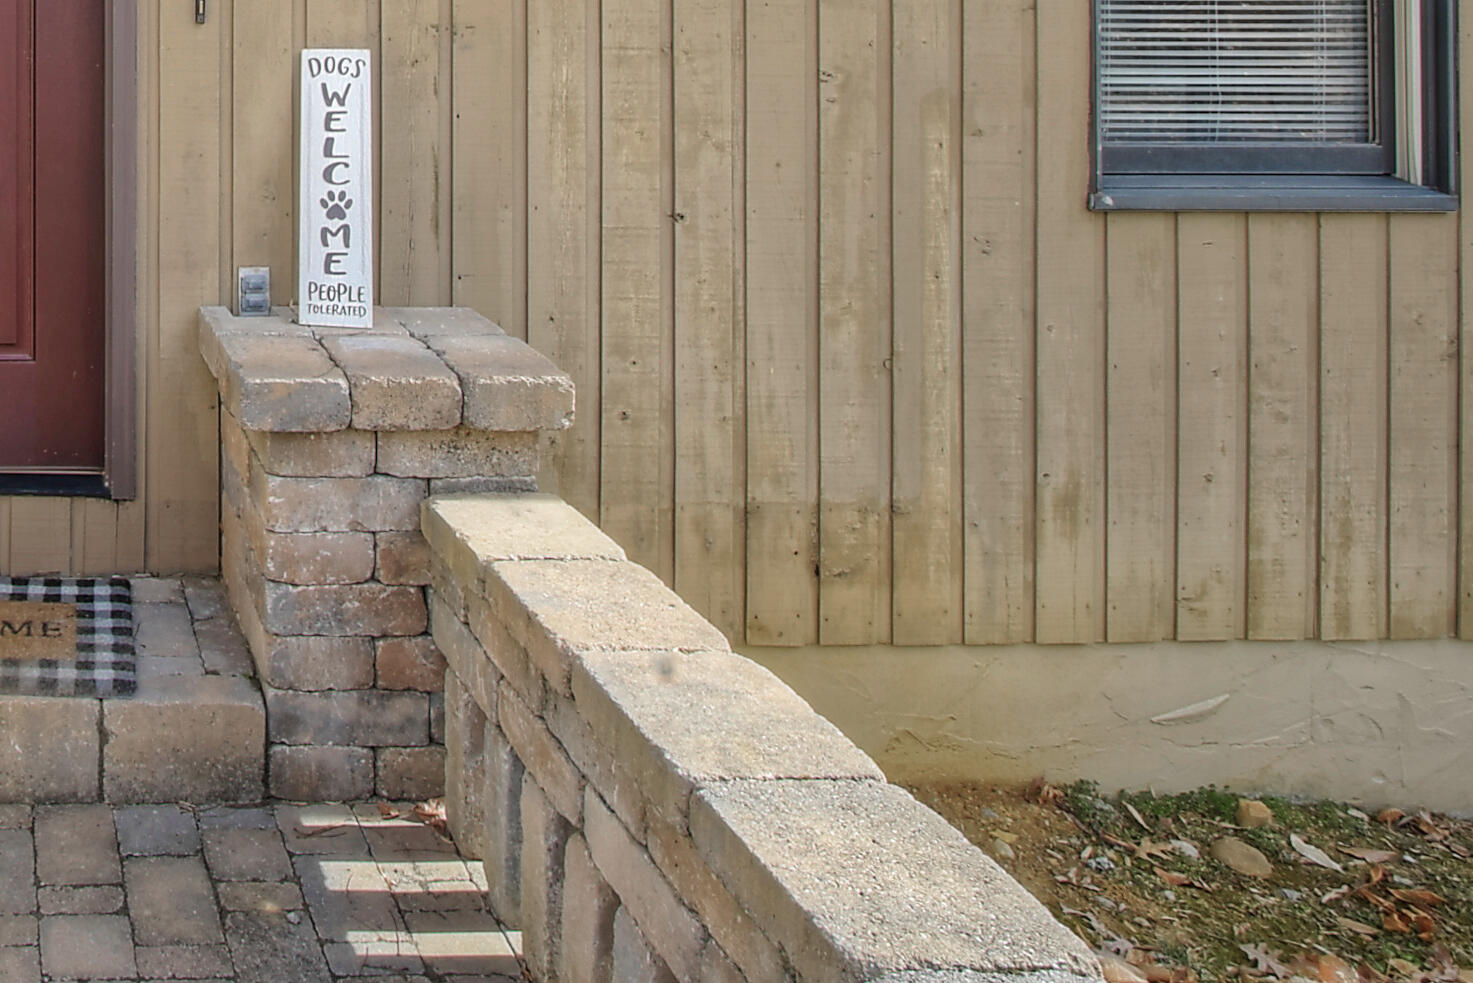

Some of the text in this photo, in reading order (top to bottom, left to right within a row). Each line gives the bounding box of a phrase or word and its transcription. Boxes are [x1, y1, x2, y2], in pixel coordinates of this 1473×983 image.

[308, 56, 366, 78] DOGS
[308, 281, 366, 303] PEOPLE
[307, 303, 367, 318] TOLERATED
